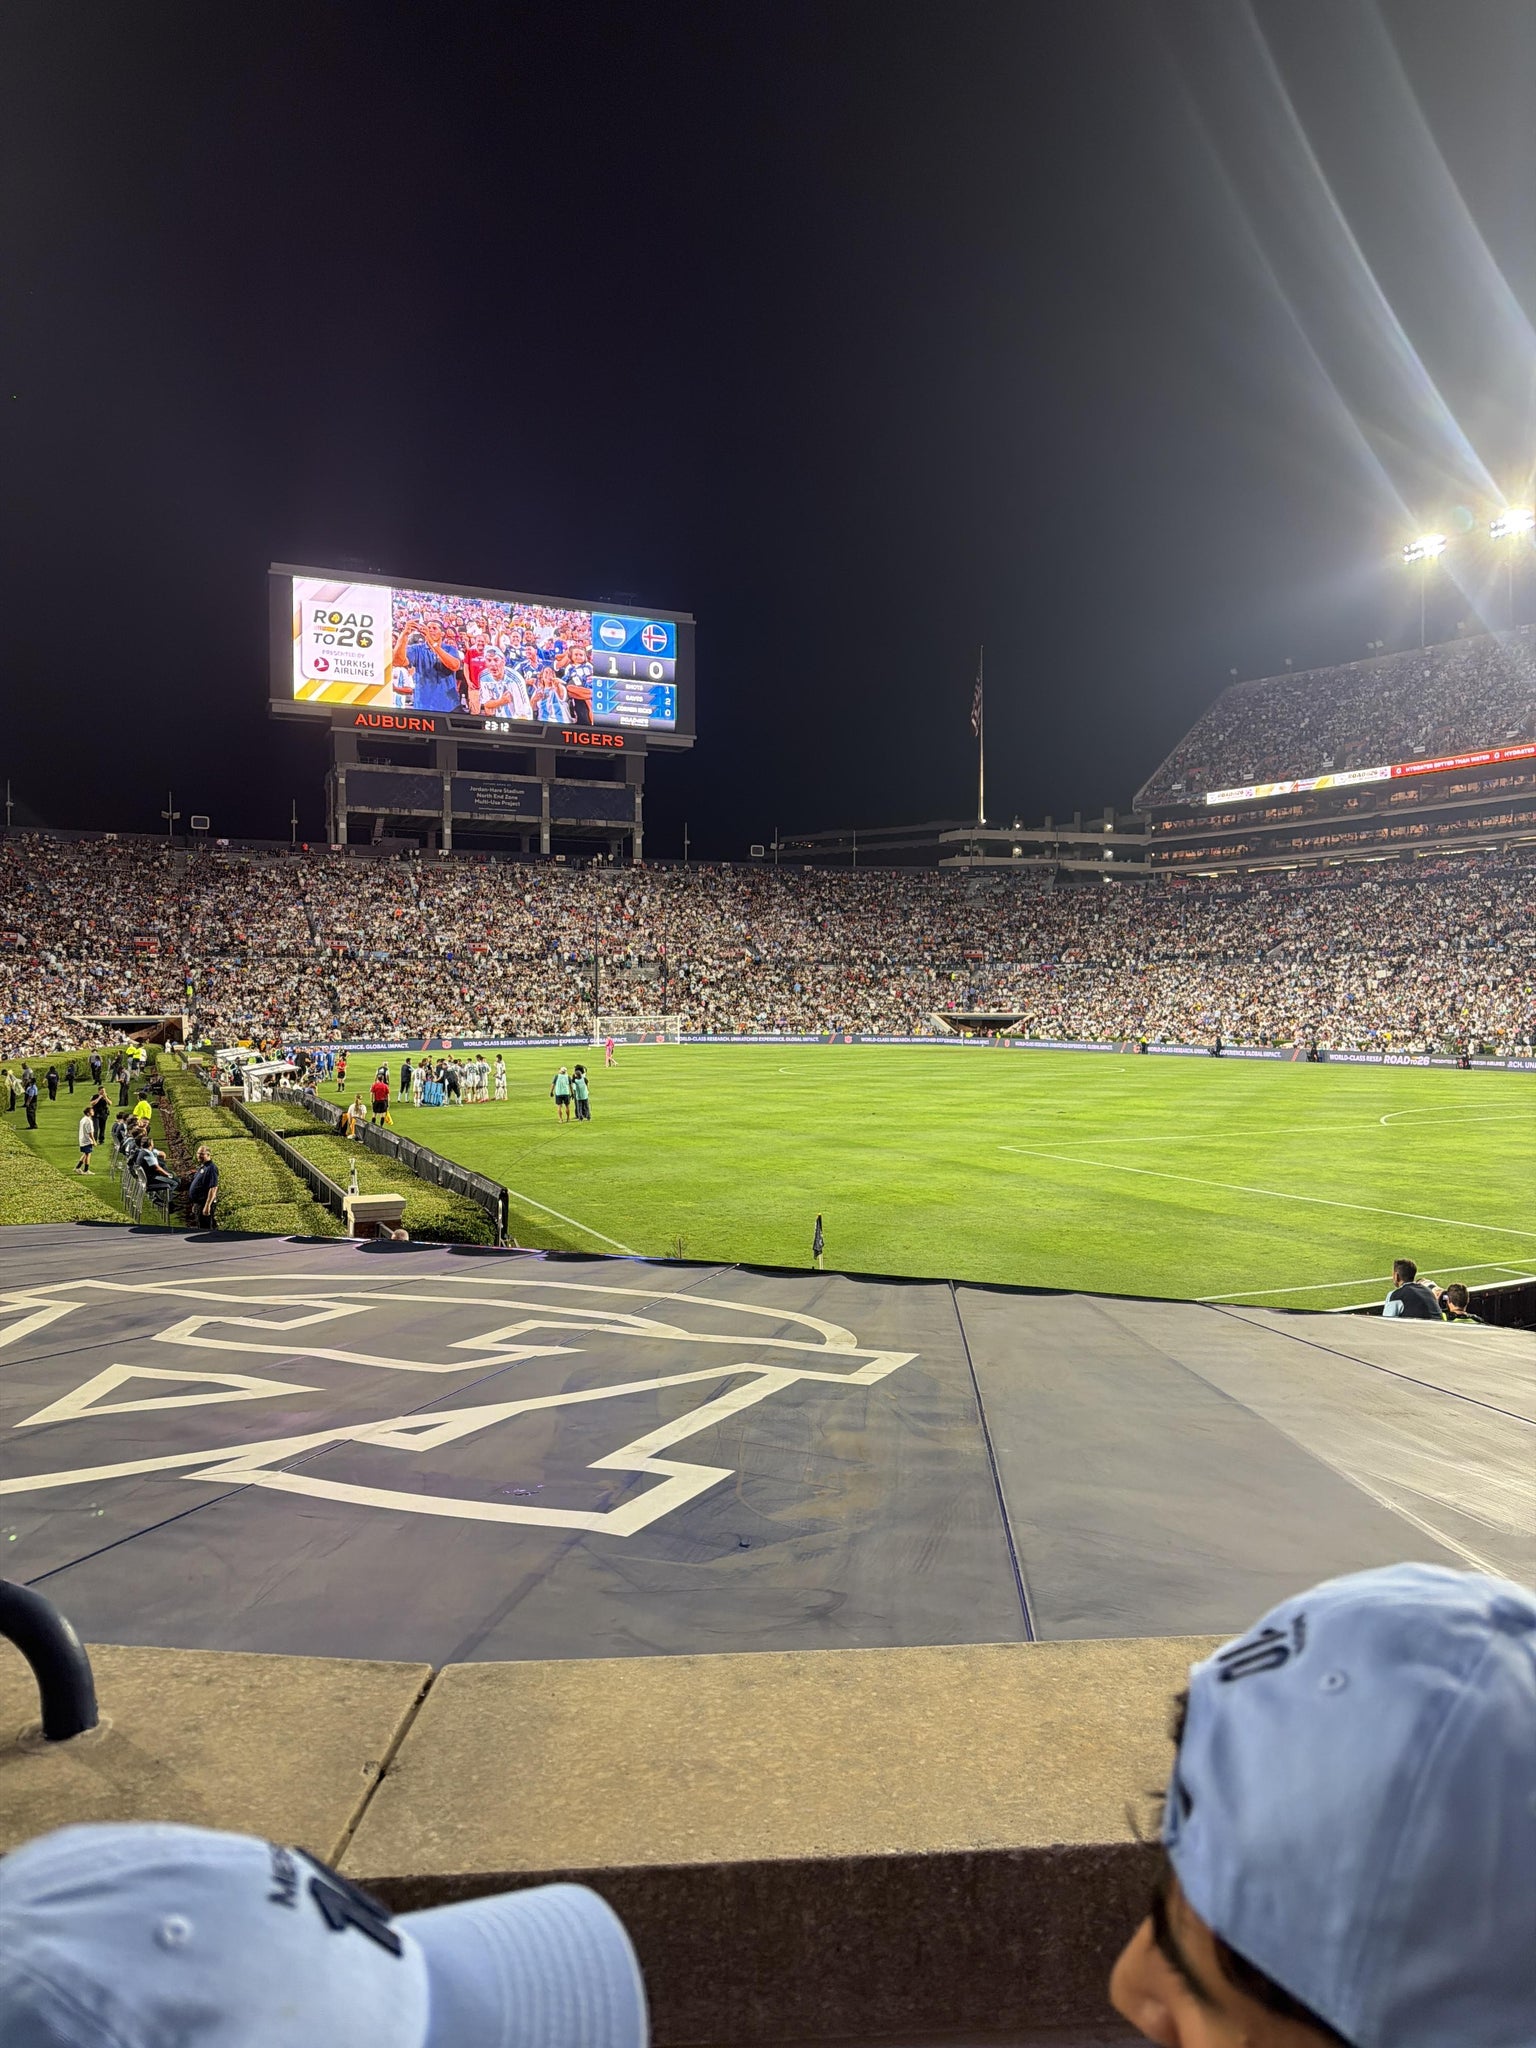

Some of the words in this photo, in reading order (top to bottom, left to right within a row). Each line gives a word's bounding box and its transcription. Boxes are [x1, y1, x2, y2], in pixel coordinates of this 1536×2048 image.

[313, 610, 374, 628] ROAD
[313, 633, 335, 645] TO
[334, 658, 374, 668] TURKISH
[609, 656, 618, 674] 1
[649, 661, 663, 679] 0
[334, 667, 374, 677] AIRLINES
[596, 702, 602, 710] 0
[665, 708, 671, 716] 0
[665, 698, 671, 706] 2
[355, 714, 434, 732] AUBURN
[562, 731, 624, 747] TIGERS
[1384, 1055, 1410, 1064] ROAD
[1217, 1628, 1289, 1683] 10
